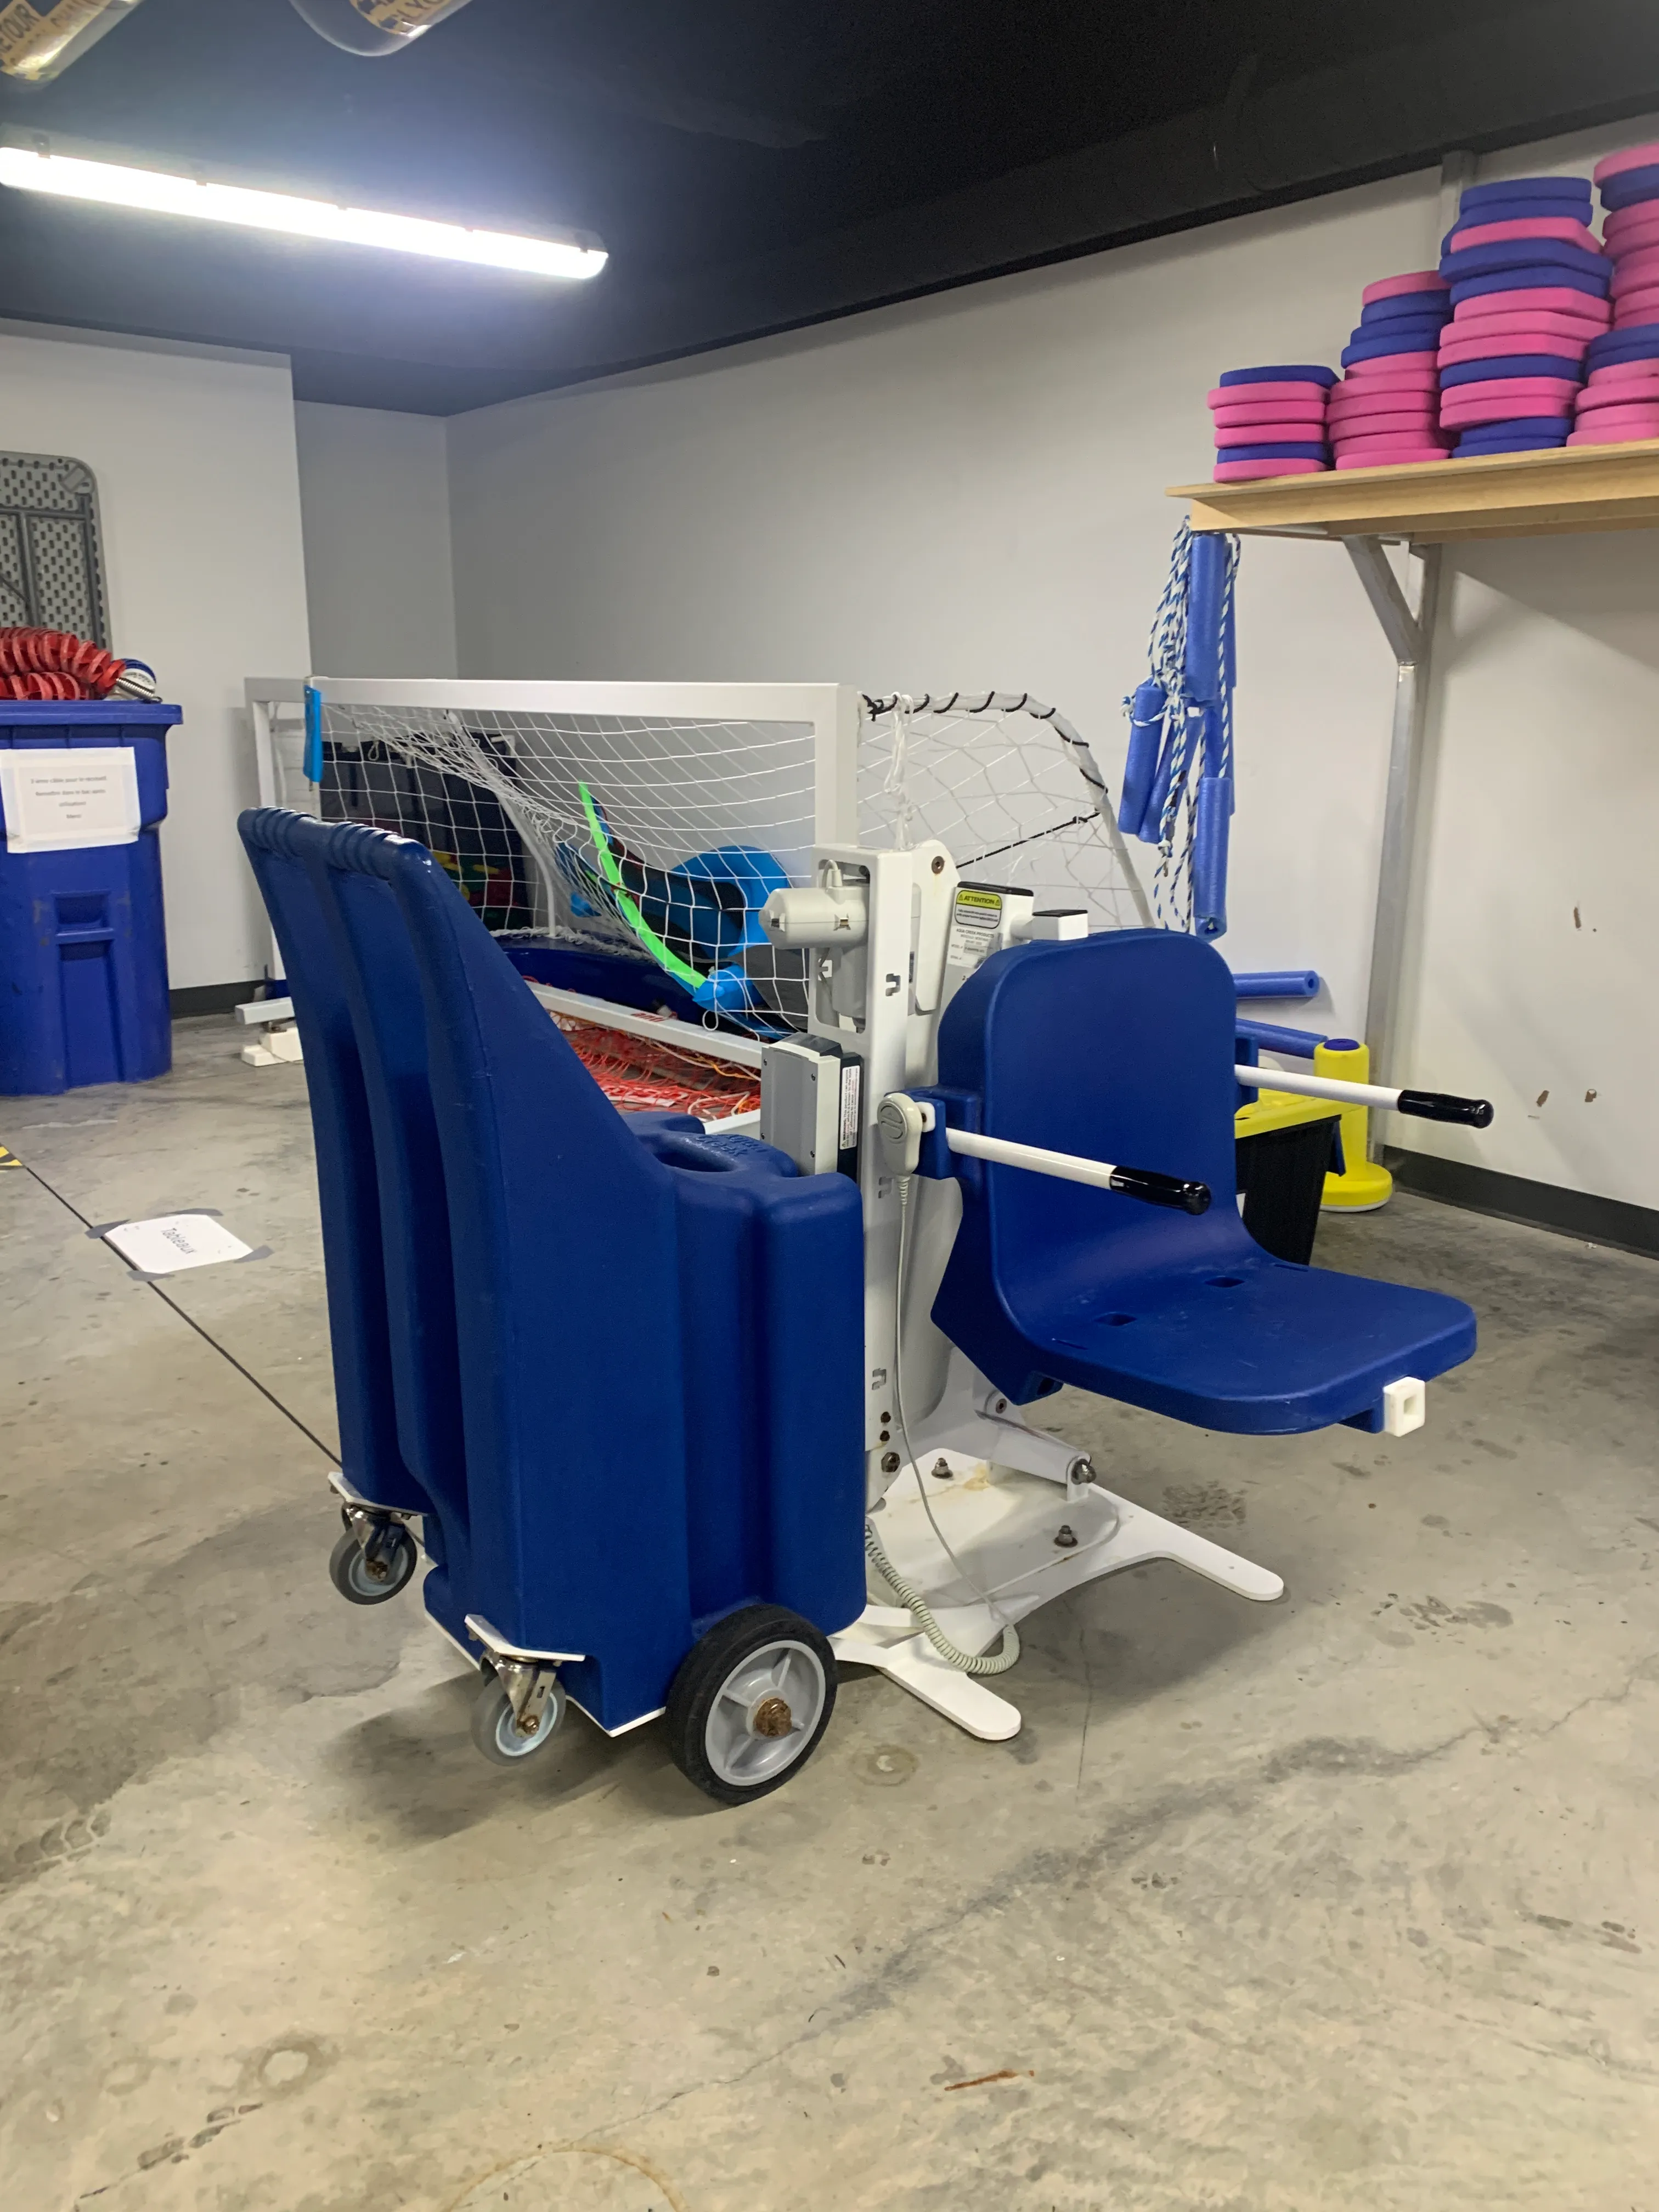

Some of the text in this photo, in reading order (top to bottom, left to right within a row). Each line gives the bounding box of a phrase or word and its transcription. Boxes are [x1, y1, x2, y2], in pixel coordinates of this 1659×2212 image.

[963, 895, 995, 905] ATTENTION
[695, 1135, 748, 1157] Creek
[161, 1228, 198, 1254] Tableaux
